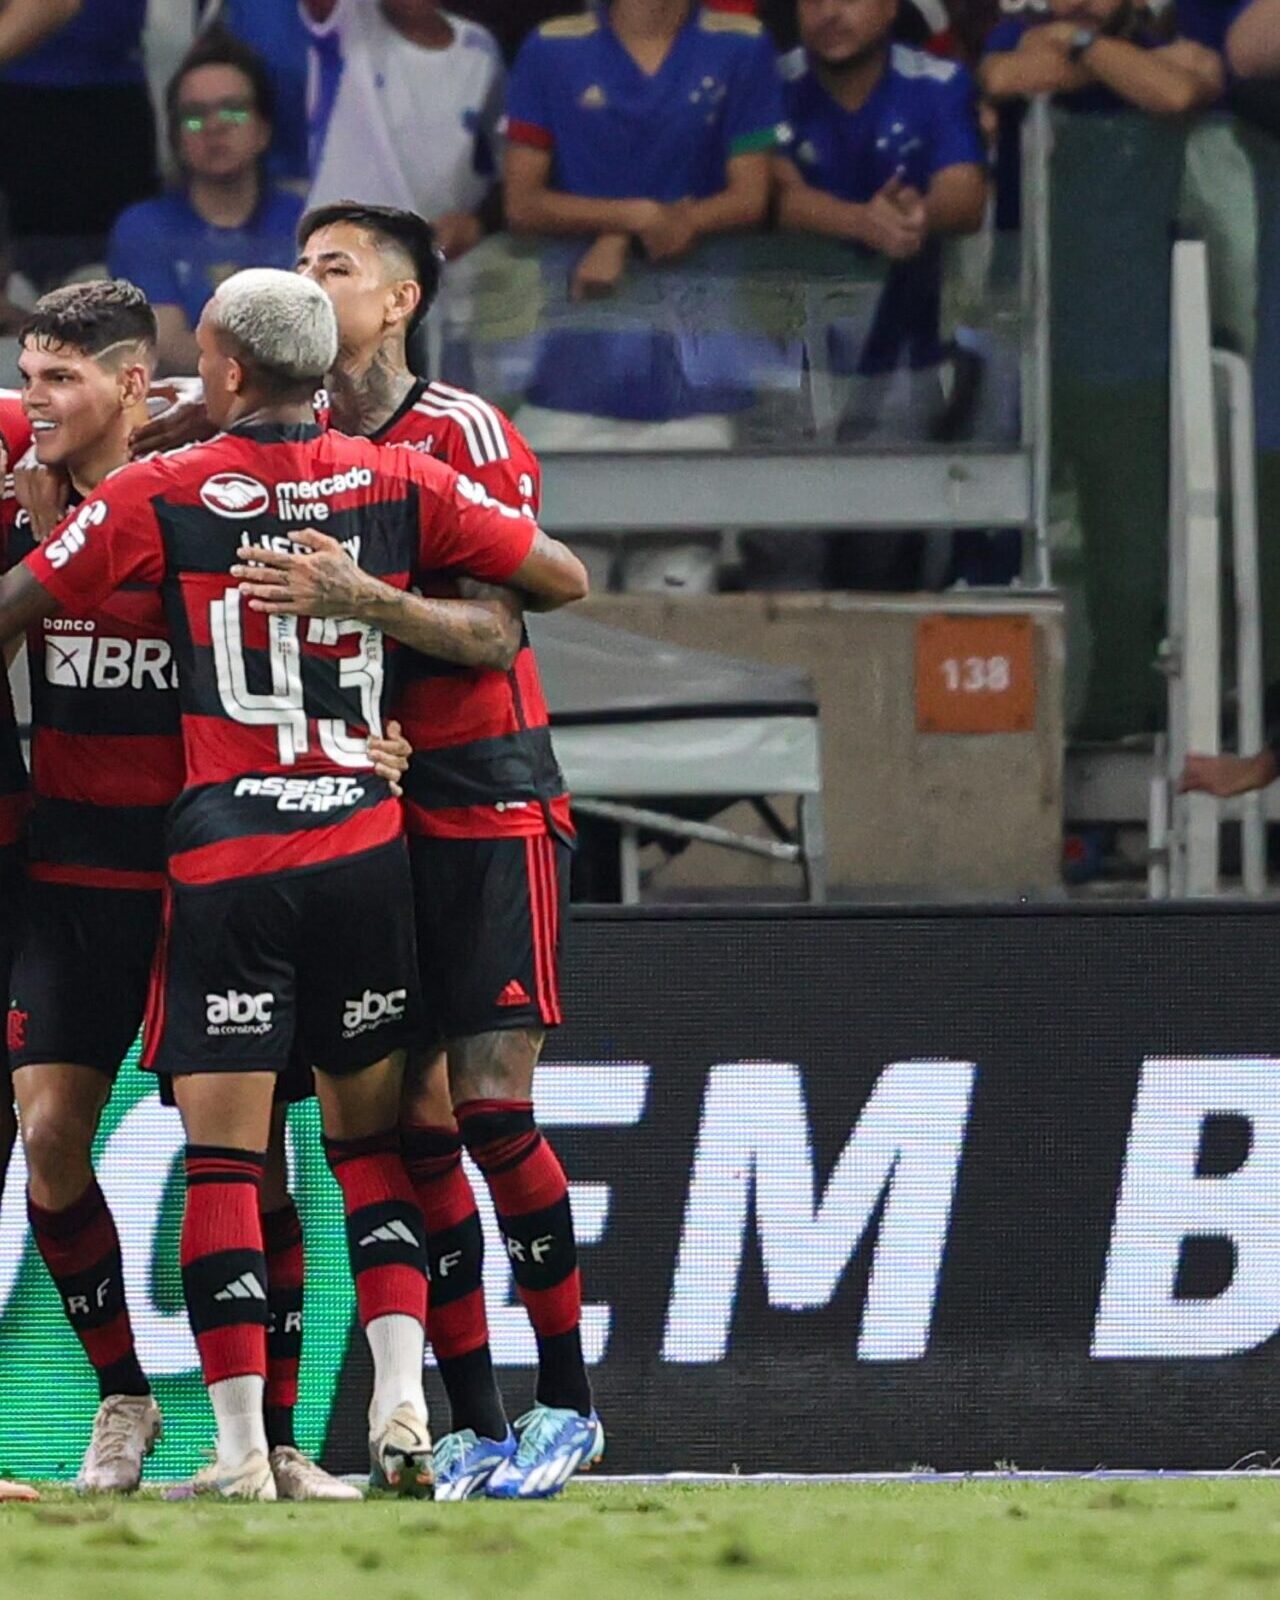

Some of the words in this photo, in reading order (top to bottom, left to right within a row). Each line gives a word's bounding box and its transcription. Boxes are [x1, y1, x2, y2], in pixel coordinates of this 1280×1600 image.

[275, 467, 373, 500] mercado
[278, 500, 329, 521] livre
[43, 617, 96, 632] banco
[92, 637, 180, 690] BR
[210, 588, 385, 768] 43
[941, 655, 1011, 692] 138
[233, 776, 357, 797] ASSIST
[205, 989, 274, 1025] abc
[342, 988, 407, 1029] abc
